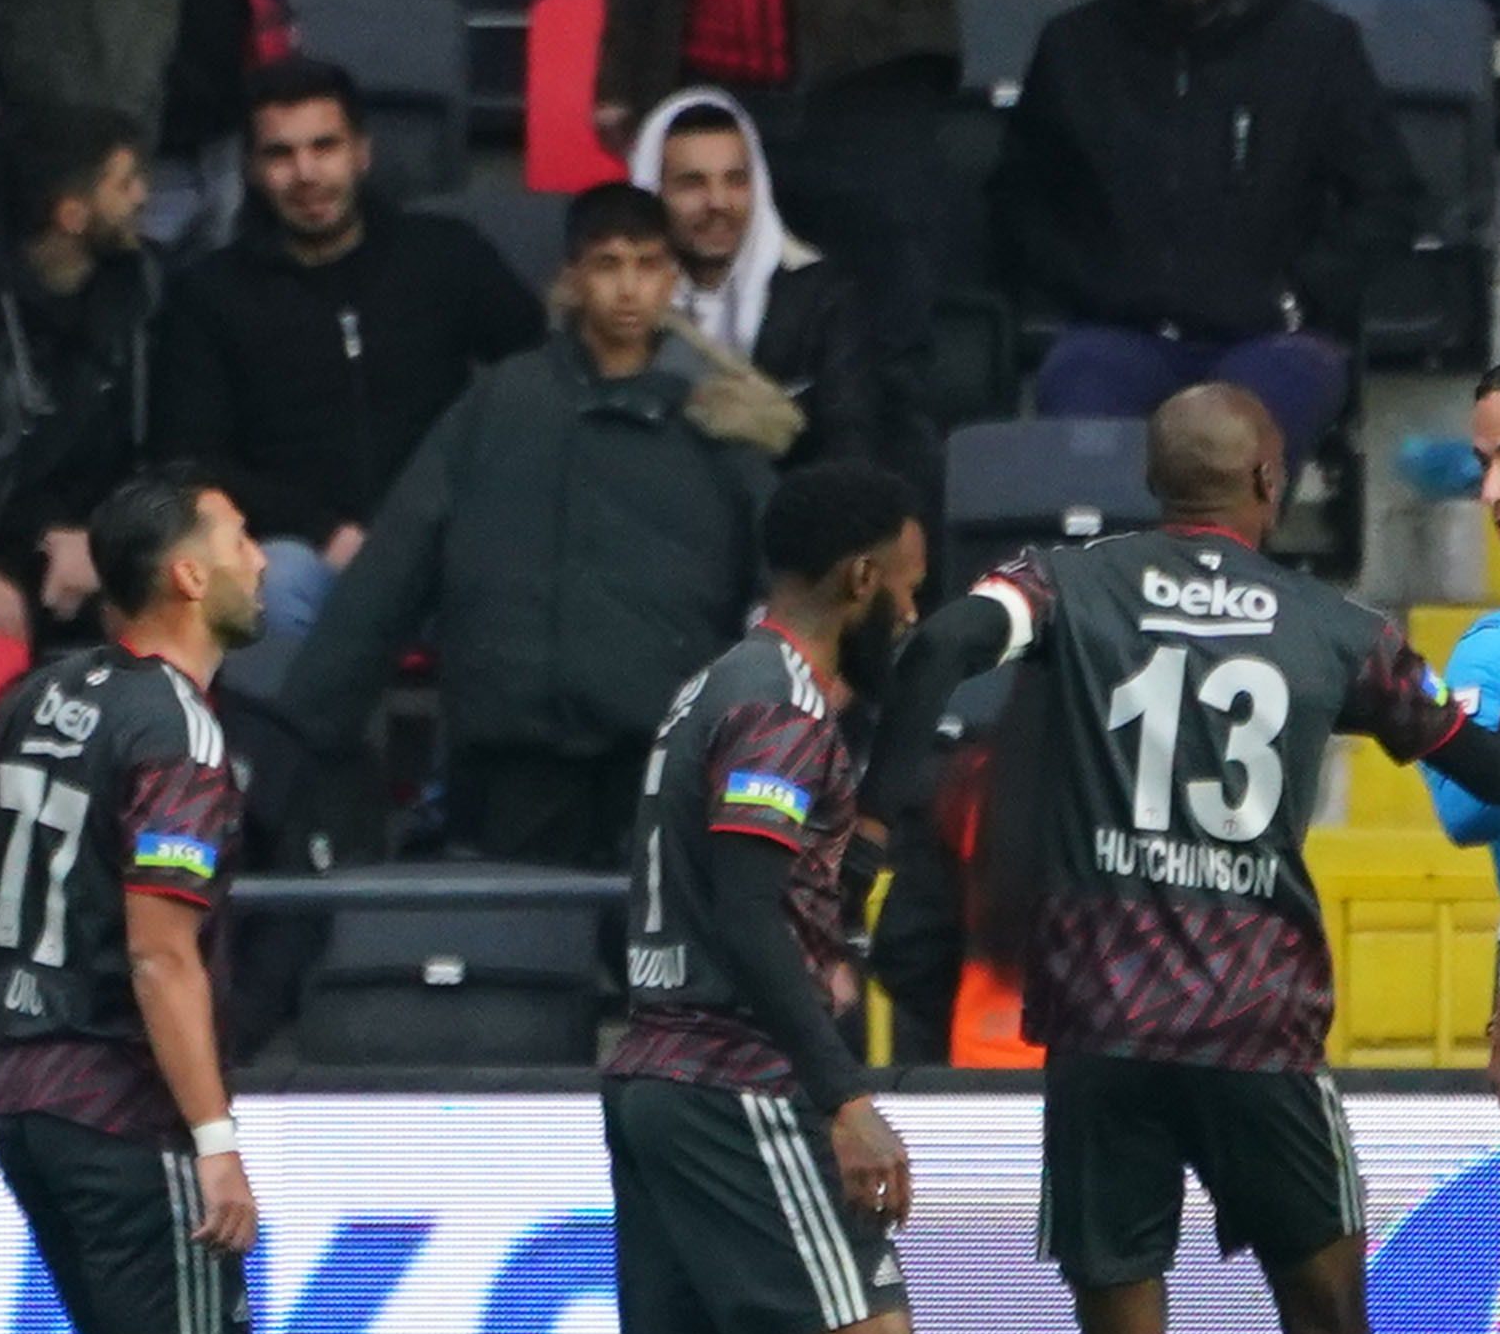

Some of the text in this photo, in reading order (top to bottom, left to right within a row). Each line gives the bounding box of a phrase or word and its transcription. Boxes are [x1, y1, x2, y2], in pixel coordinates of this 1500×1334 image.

[1142, 570, 1278, 621] beko
[1107, 646, 1290, 842] 13
[746, 780, 797, 808] aksa
[1095, 827, 1281, 898] HUTCHINSON
